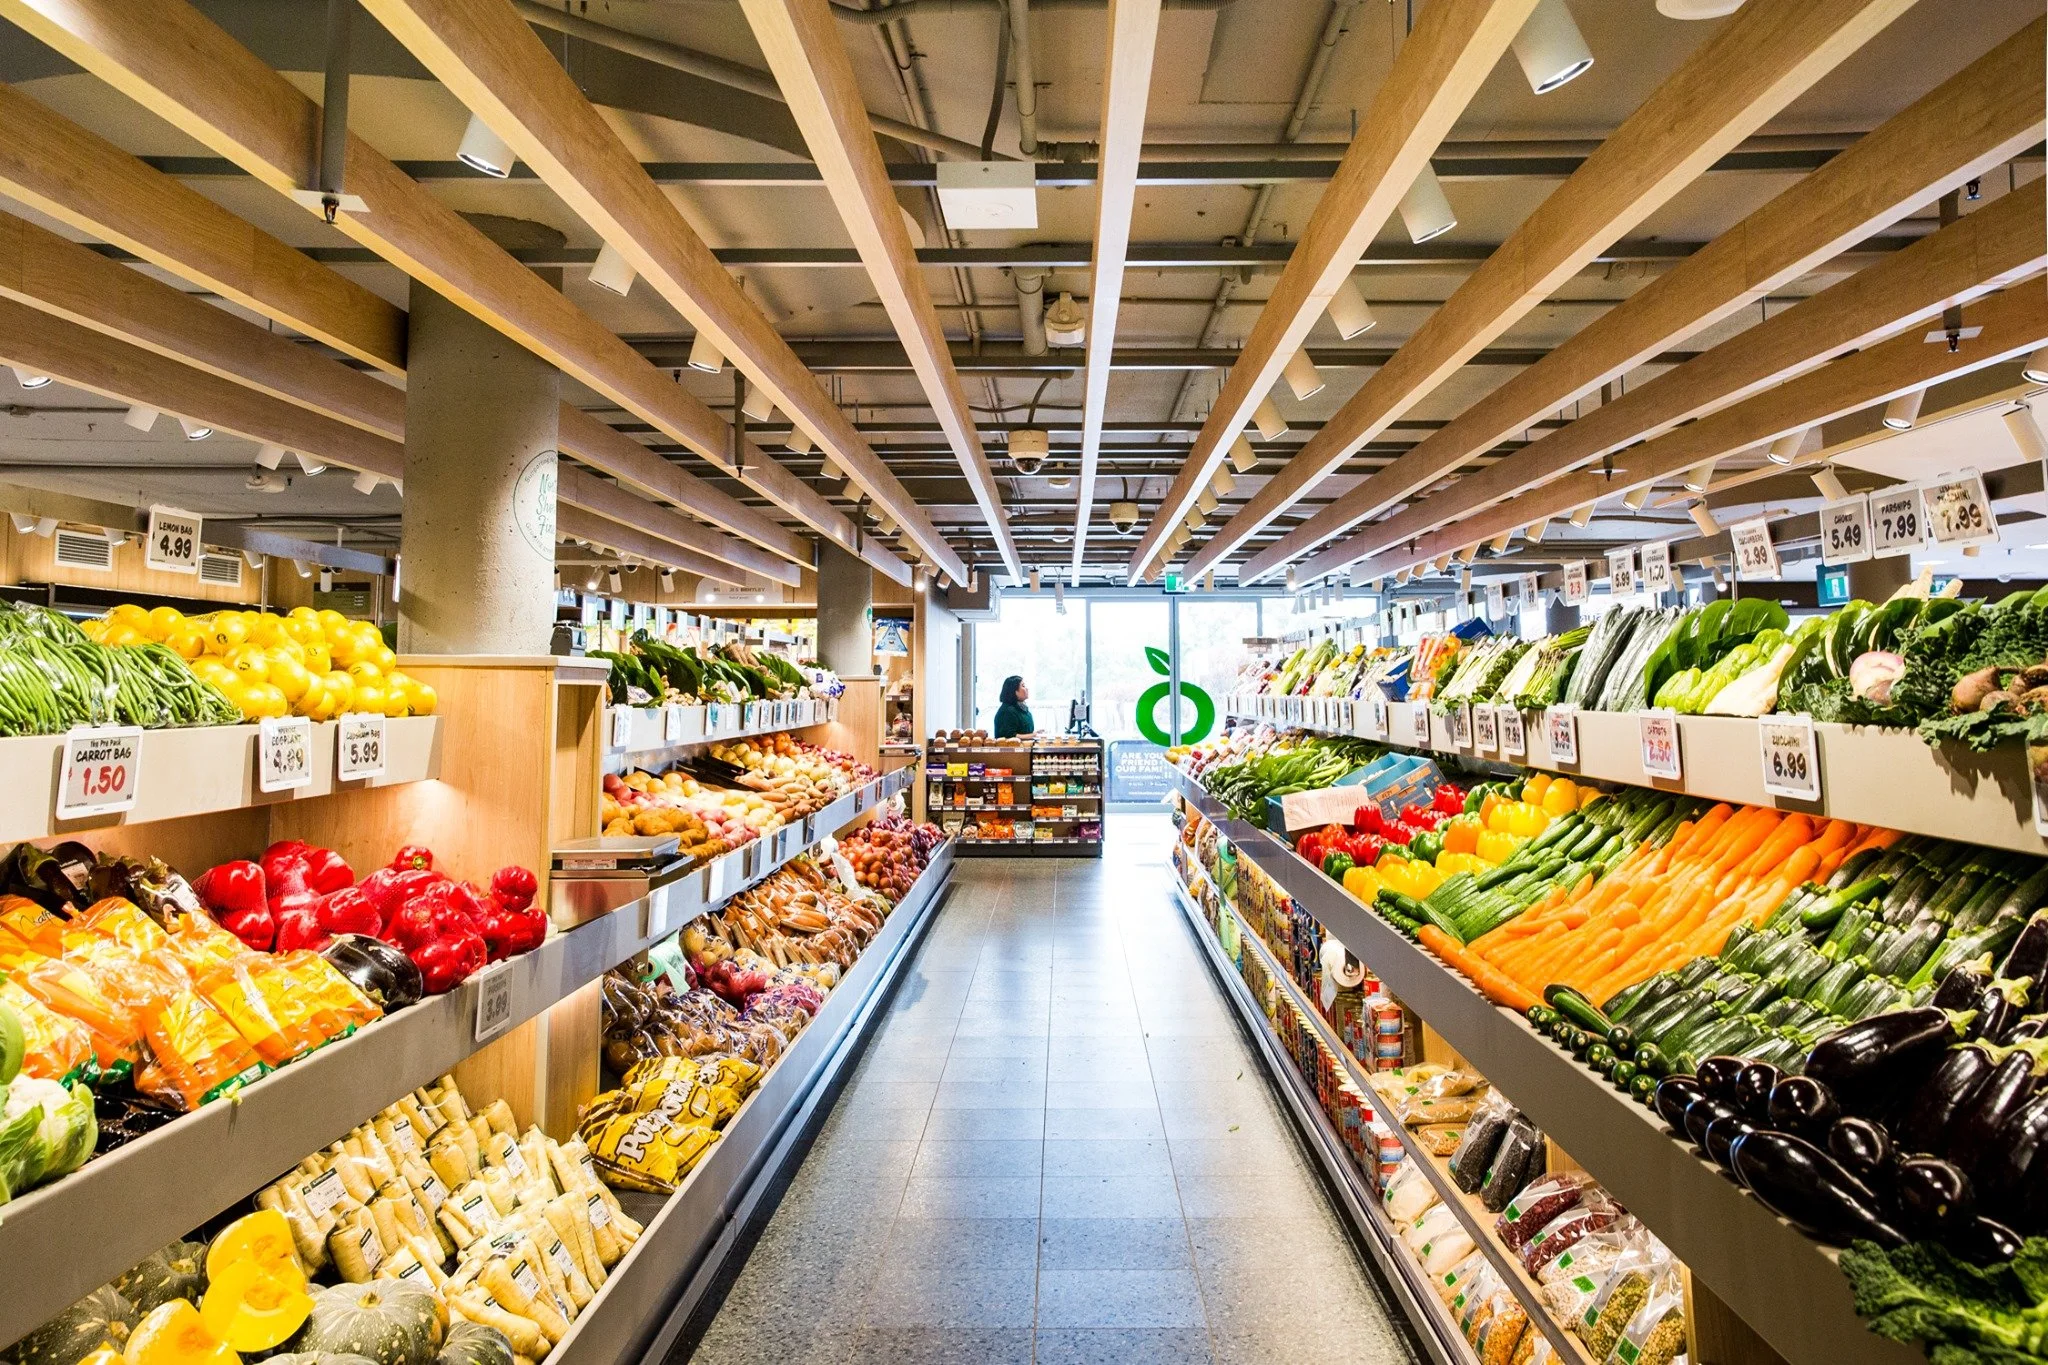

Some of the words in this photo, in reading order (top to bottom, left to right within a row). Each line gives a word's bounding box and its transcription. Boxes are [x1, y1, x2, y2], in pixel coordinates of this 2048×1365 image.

[159, 521, 179, 533] LEMON
[180, 525, 192, 535] BAG
[1882, 513, 1916, 541] 7.99
[1941, 503, 1982, 532] 7.99
[160, 534, 192, 559] 4.99
[1831, 524, 1861, 550] 5.49
[1743, 545, 1768, 566] 2.99
[76, 749, 112, 762] CARROT
[114, 747, 131, 760] BAG
[351, 741, 379, 764] 5.99
[1773, 751, 1807, 780] 6.99
[83, 765, 126, 796] 1.50
[486, 991, 507, 1021] 3.99
